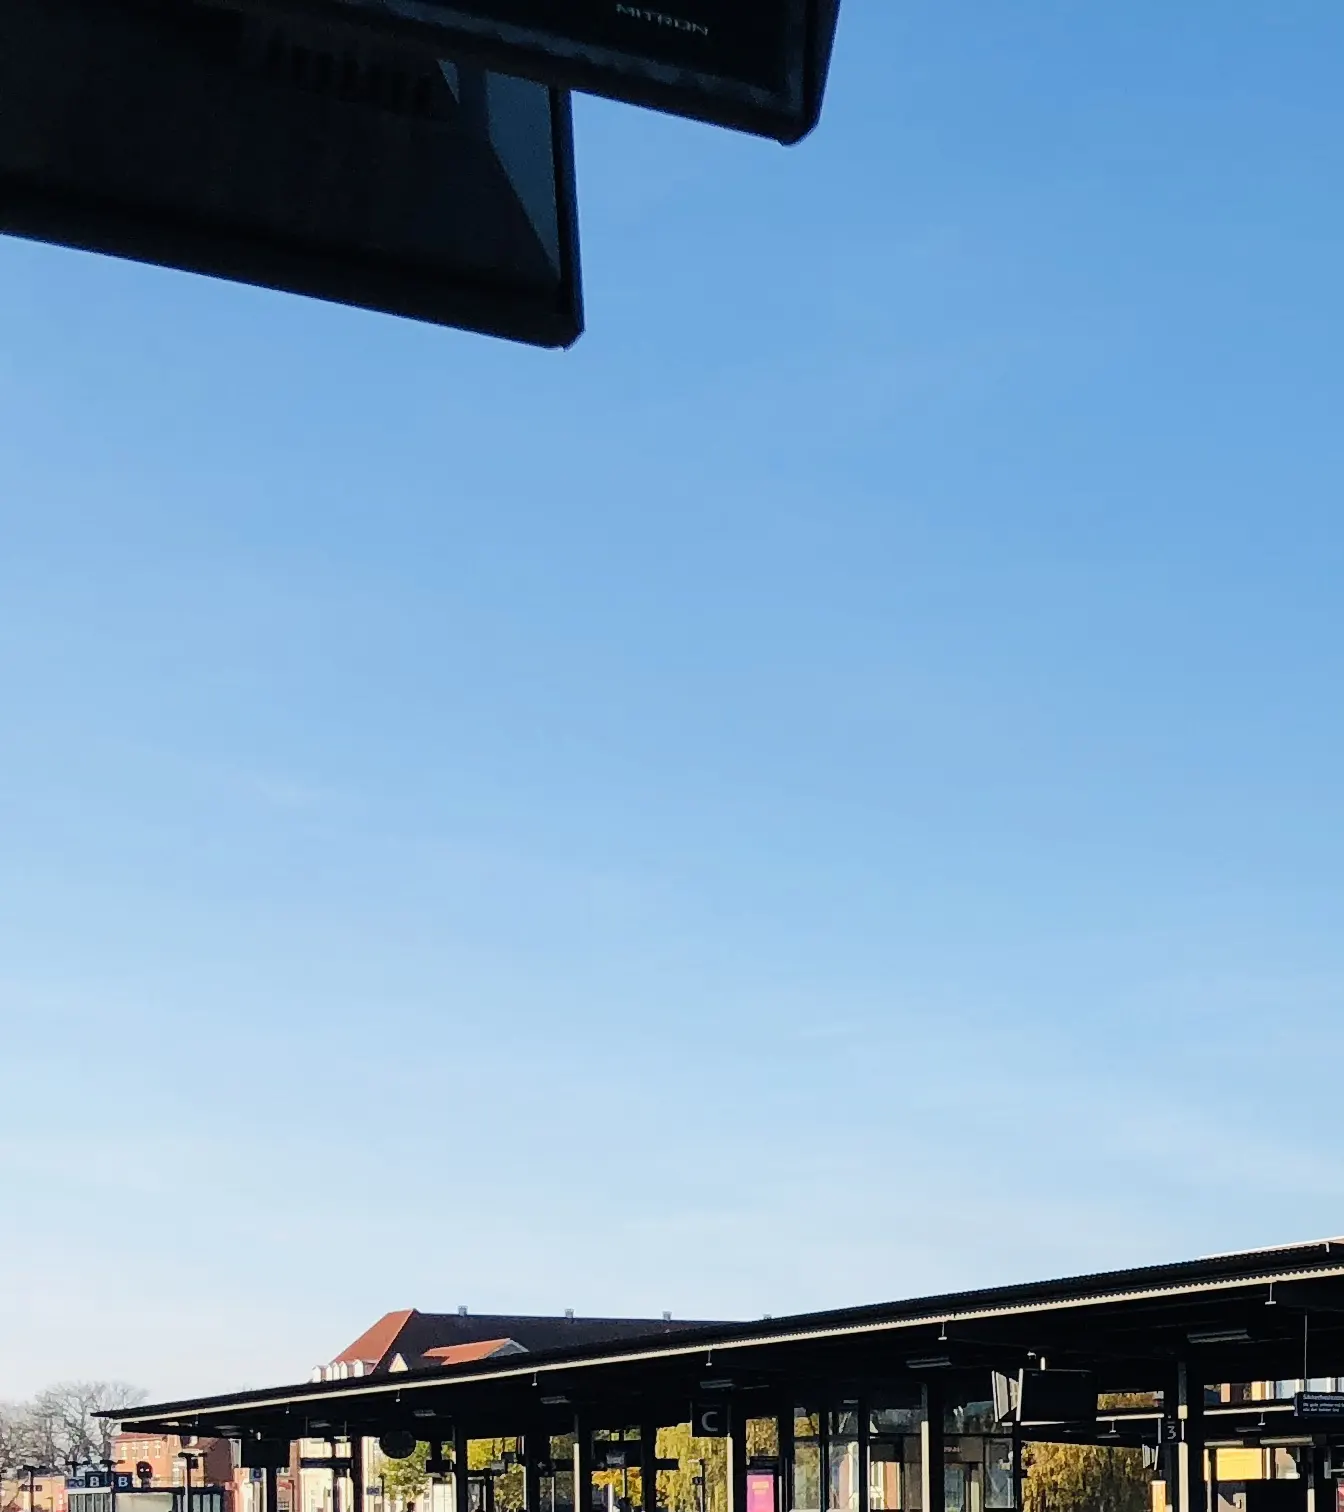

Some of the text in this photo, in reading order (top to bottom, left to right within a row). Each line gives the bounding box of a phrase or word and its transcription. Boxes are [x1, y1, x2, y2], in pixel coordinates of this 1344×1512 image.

[616, 3, 708, 36] MITRON
[701, 1411, 719, 1432] C
[1167, 1425, 1177, 1440] 3
[118, 1476, 128, 1487] B
